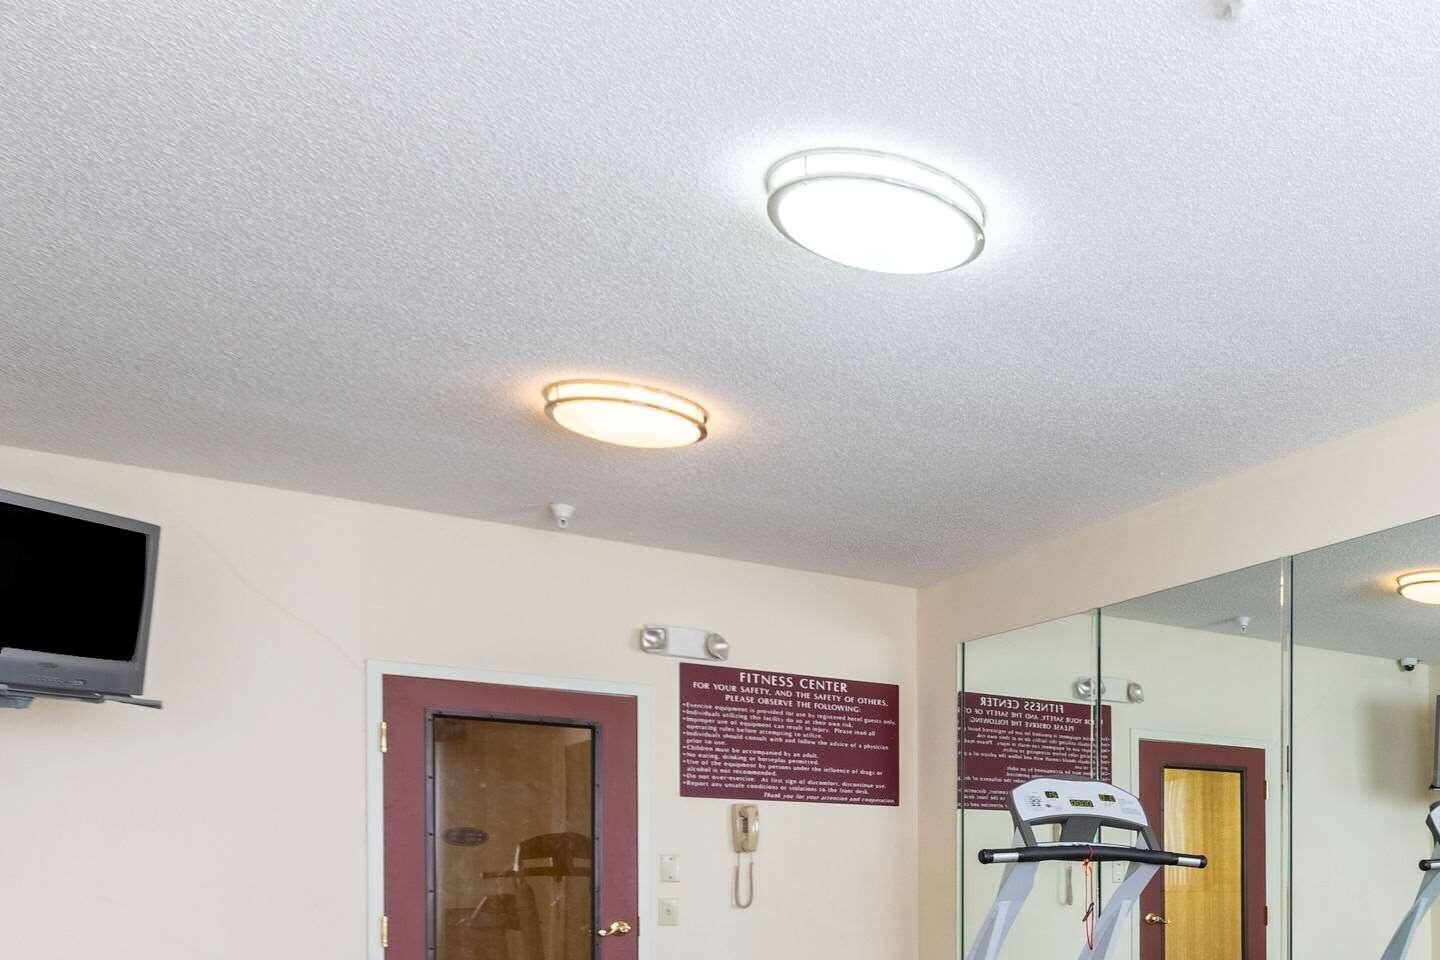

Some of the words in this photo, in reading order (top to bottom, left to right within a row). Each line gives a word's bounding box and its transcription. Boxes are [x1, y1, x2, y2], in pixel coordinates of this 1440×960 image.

[740, 672, 793, 688] FITNESS
[800, 678, 848, 693] CENTER
[713, 683, 737, 692] YOUR
[795, 691, 810, 699] THE
[814, 693, 842, 702] SAFETY
[725, 694, 754, 703] PLEASE
[757, 697, 793, 707] OBSERVE
[797, 701, 813, 709] THE
[814, 703, 861, 713] FOLLOWING:
